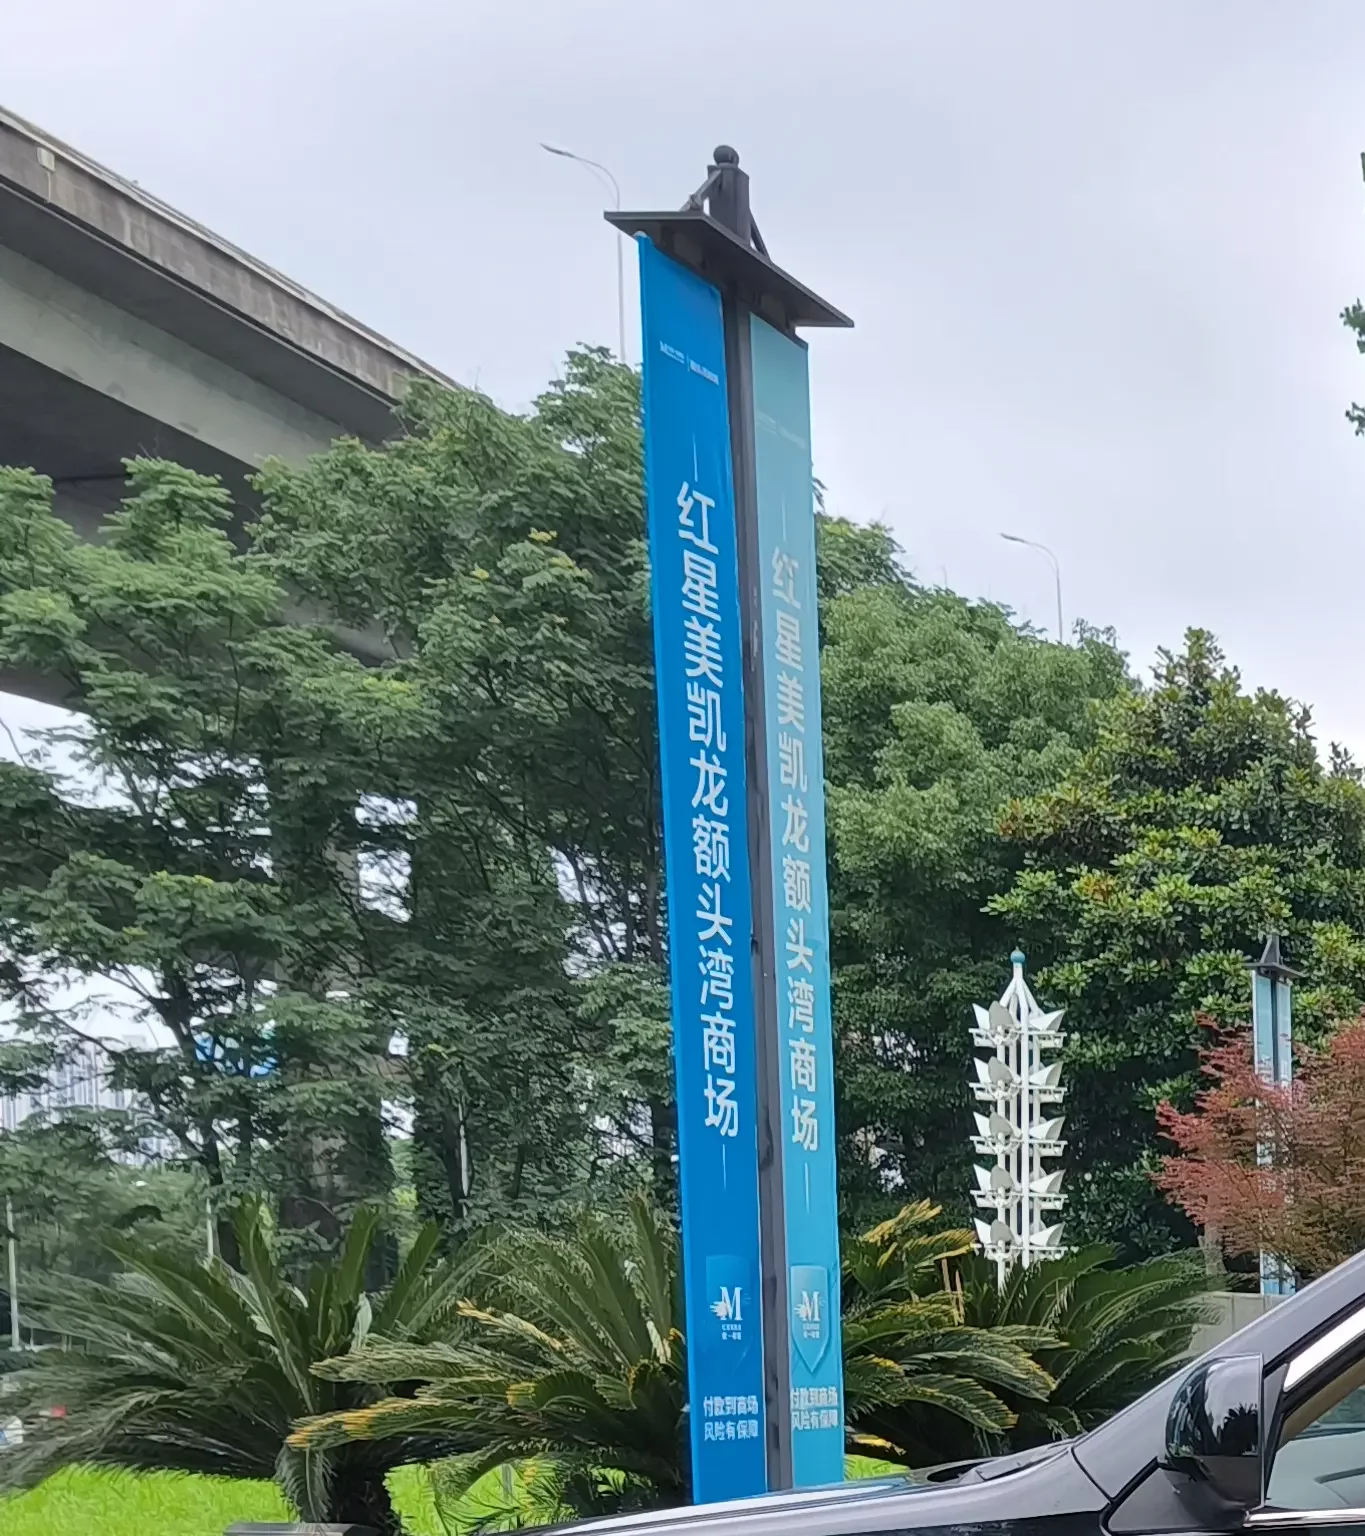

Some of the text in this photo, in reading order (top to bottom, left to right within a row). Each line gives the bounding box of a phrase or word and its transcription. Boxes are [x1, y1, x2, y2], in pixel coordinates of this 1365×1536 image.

[676, 480, 740, 1138] 红星美凯龙额头湾商场
[771, 546, 819, 1152] 红星美凯龙额头湾商场
[703, 1395, 759, 1418] 付款到商场
[790, 1386, 839, 1410] 付款到商场
[704, 1419, 759, 1442] 风险有保障
[791, 1409, 839, 1431] 风险有保障
